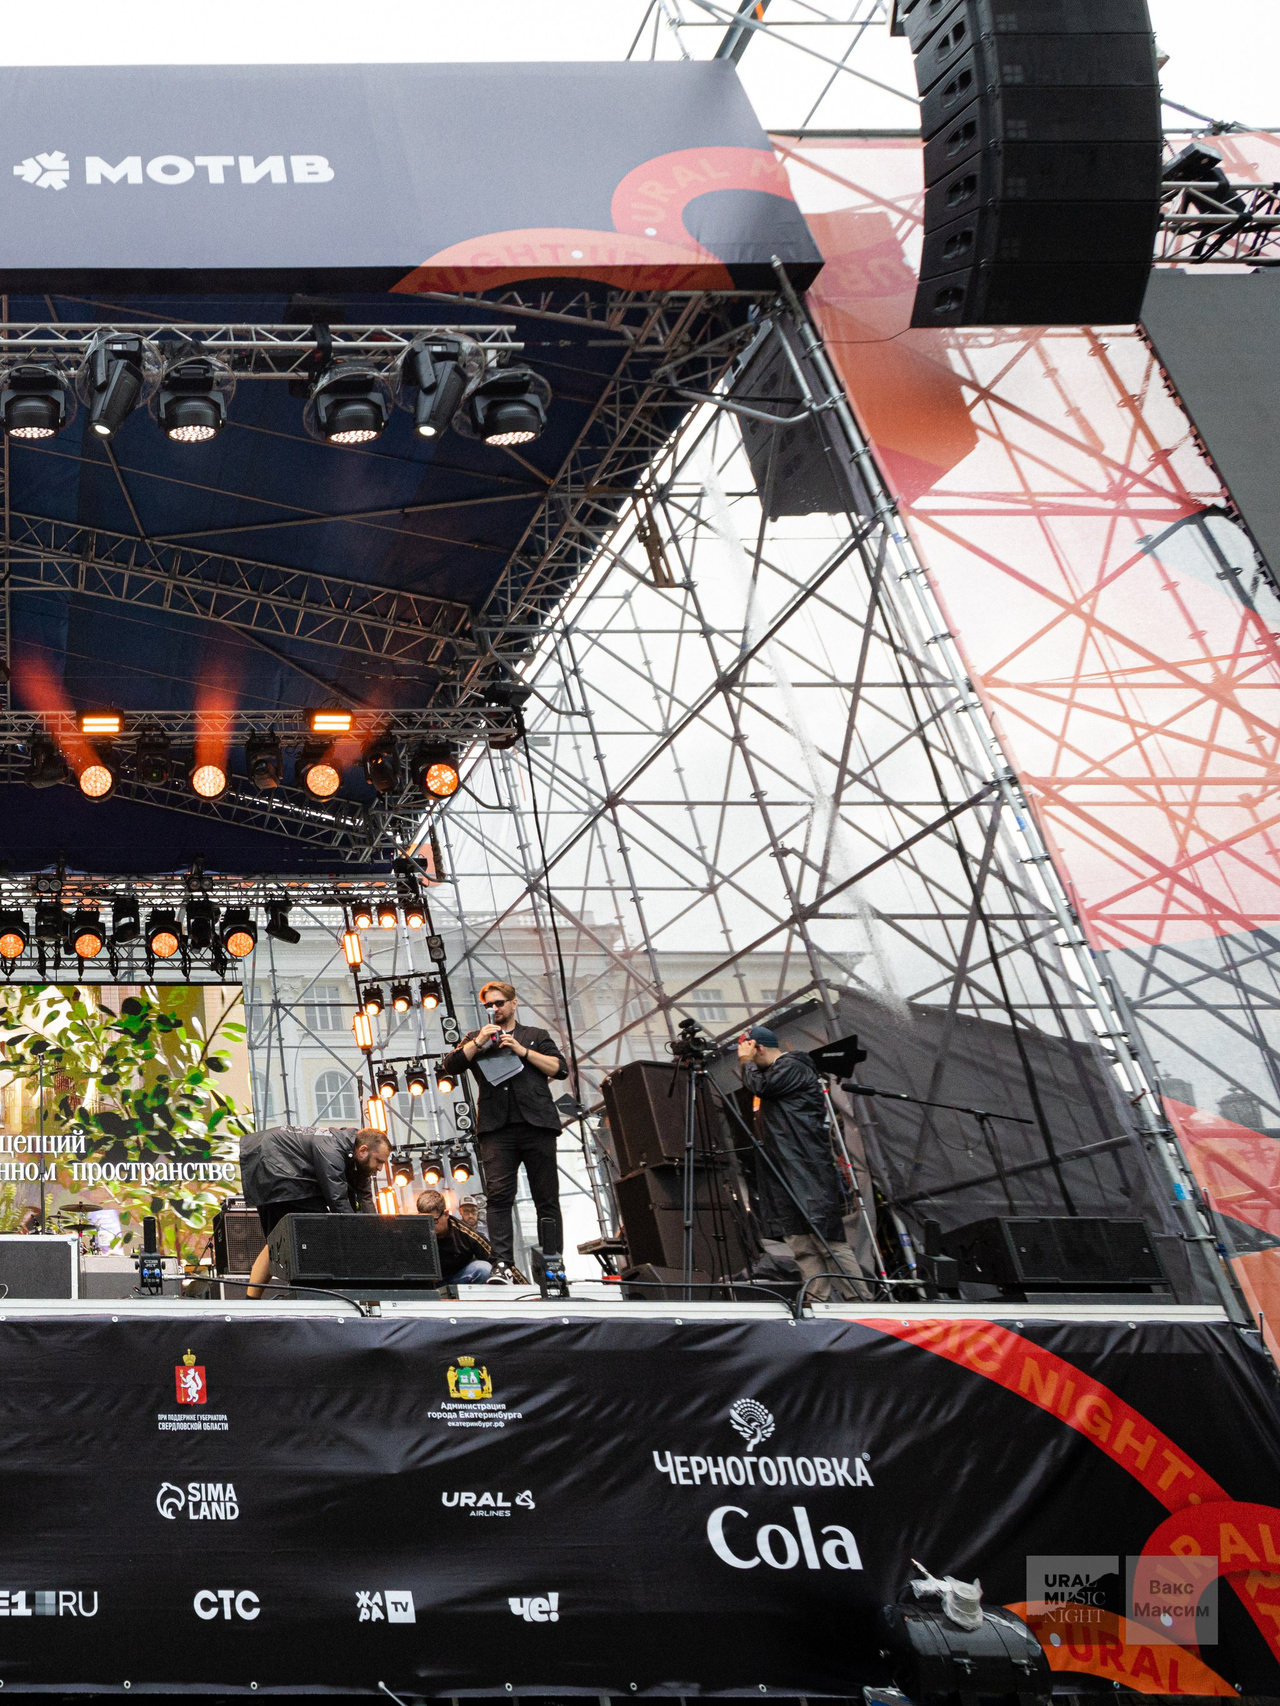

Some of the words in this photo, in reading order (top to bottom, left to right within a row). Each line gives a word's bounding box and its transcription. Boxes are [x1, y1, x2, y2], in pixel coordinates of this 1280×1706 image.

[86, 154, 335, 185] МОТИВ
[72, 1161, 235, 1186] пространстве
[441, 1402, 507, 1411] Администрация
[459, 1411, 523, 1419] Екатеринбурга
[158, 1421, 202, 1431] СВЕРДЛОВСКОЙ
[203, 1422, 229, 1431] ОБЛАСТИ
[1019, 1357, 1195, 1491] NIGHT
[188, 1482, 238, 1502] SIMA
[442, 1491, 512, 1507] URAL
[188, 1501, 240, 1520] LAND
[706, 1505, 864, 1570] Cola
[193, 1589, 261, 1621] СТС
[390, 1601, 409, 1613] TV
